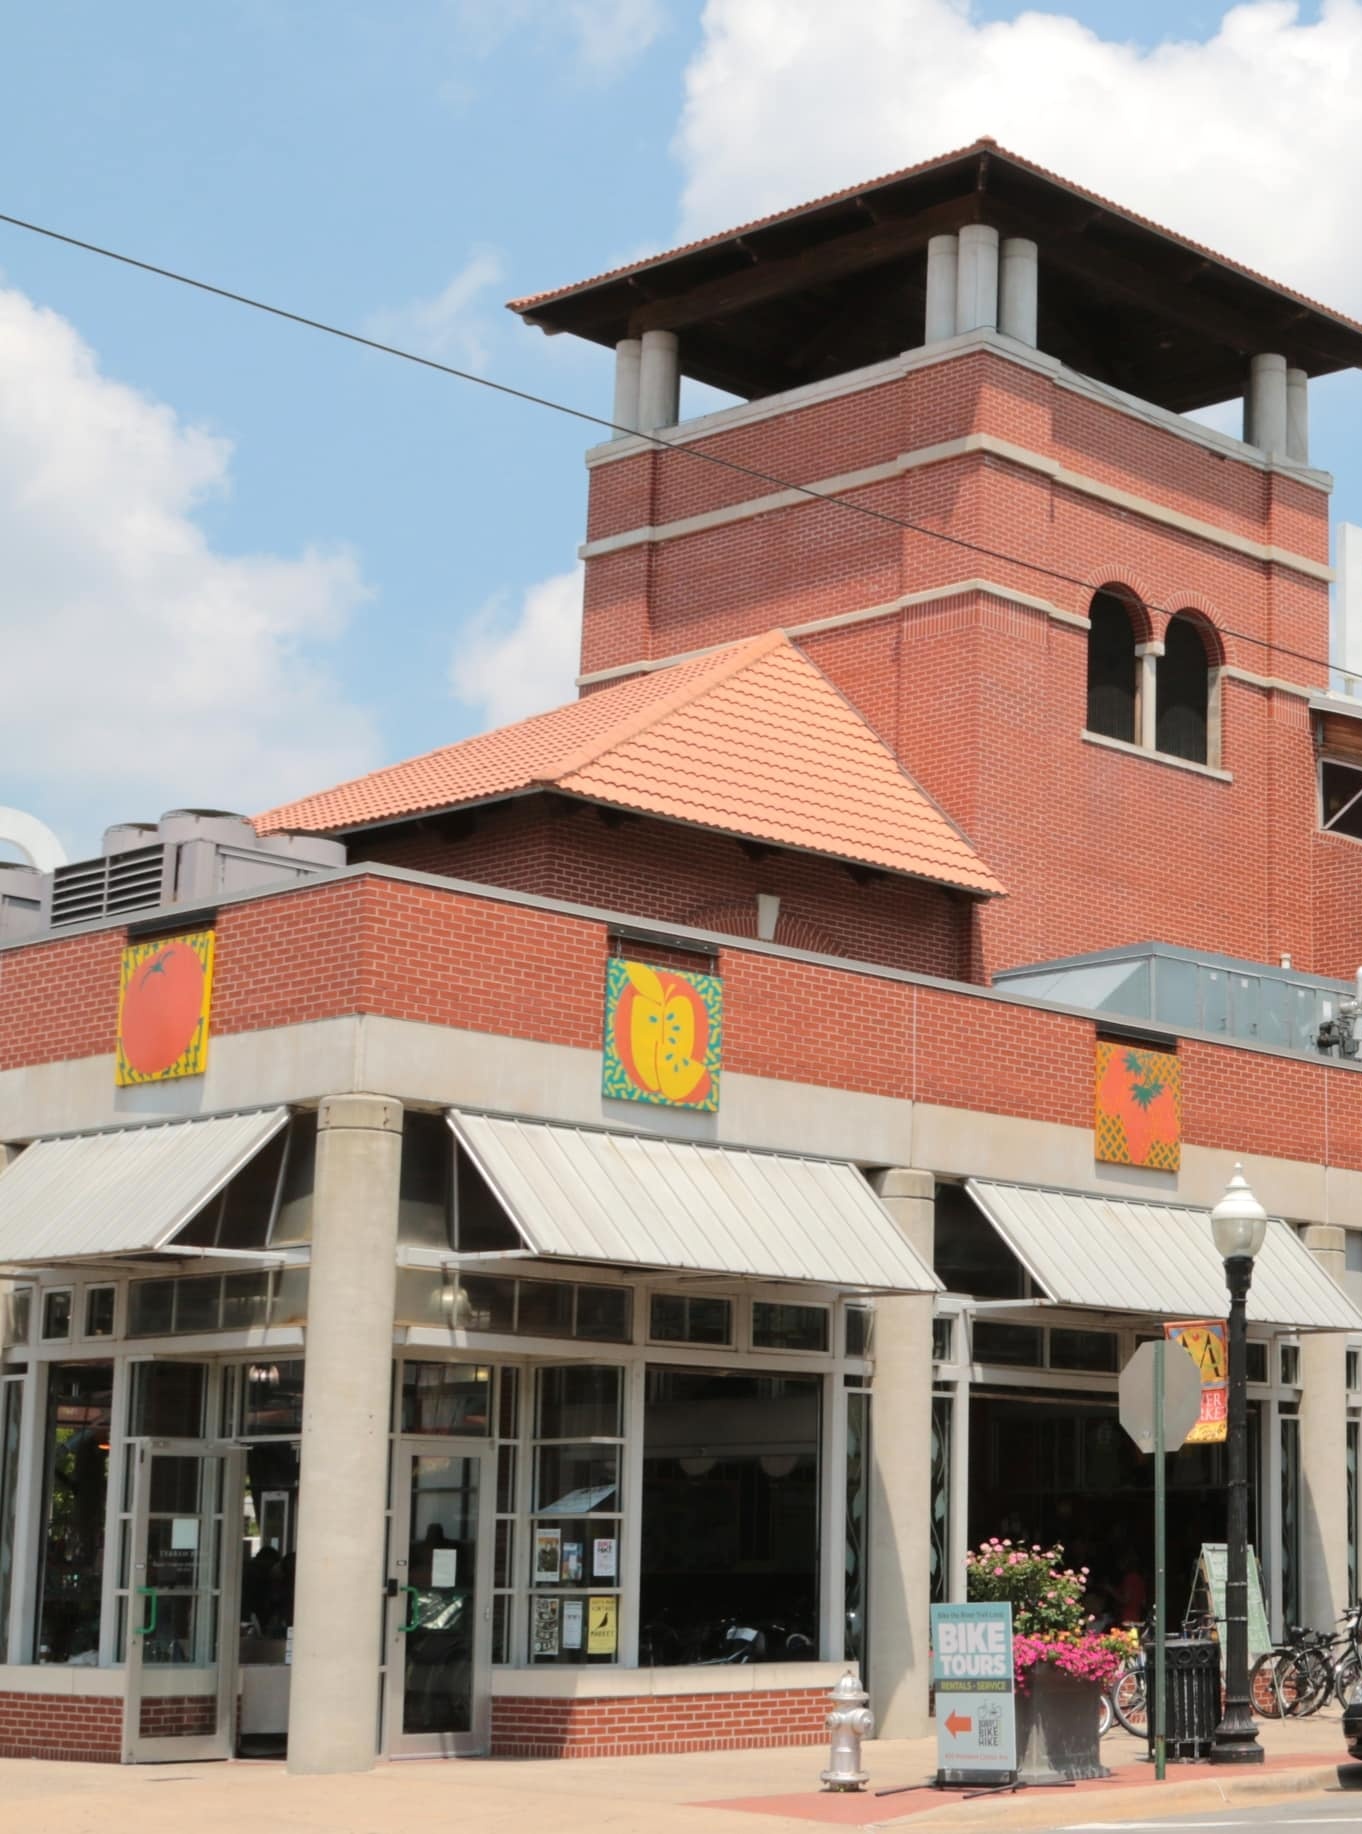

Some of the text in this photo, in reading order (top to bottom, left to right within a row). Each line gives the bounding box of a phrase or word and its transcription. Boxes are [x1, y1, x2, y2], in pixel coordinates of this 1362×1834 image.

[938, 1622, 1005, 1653] BIKE
[940, 1654, 1006, 1676] TOURS
[941, 1681, 1006, 1691] RENTALS SERVICE
[978, 1727, 999, 1737] BIKE
